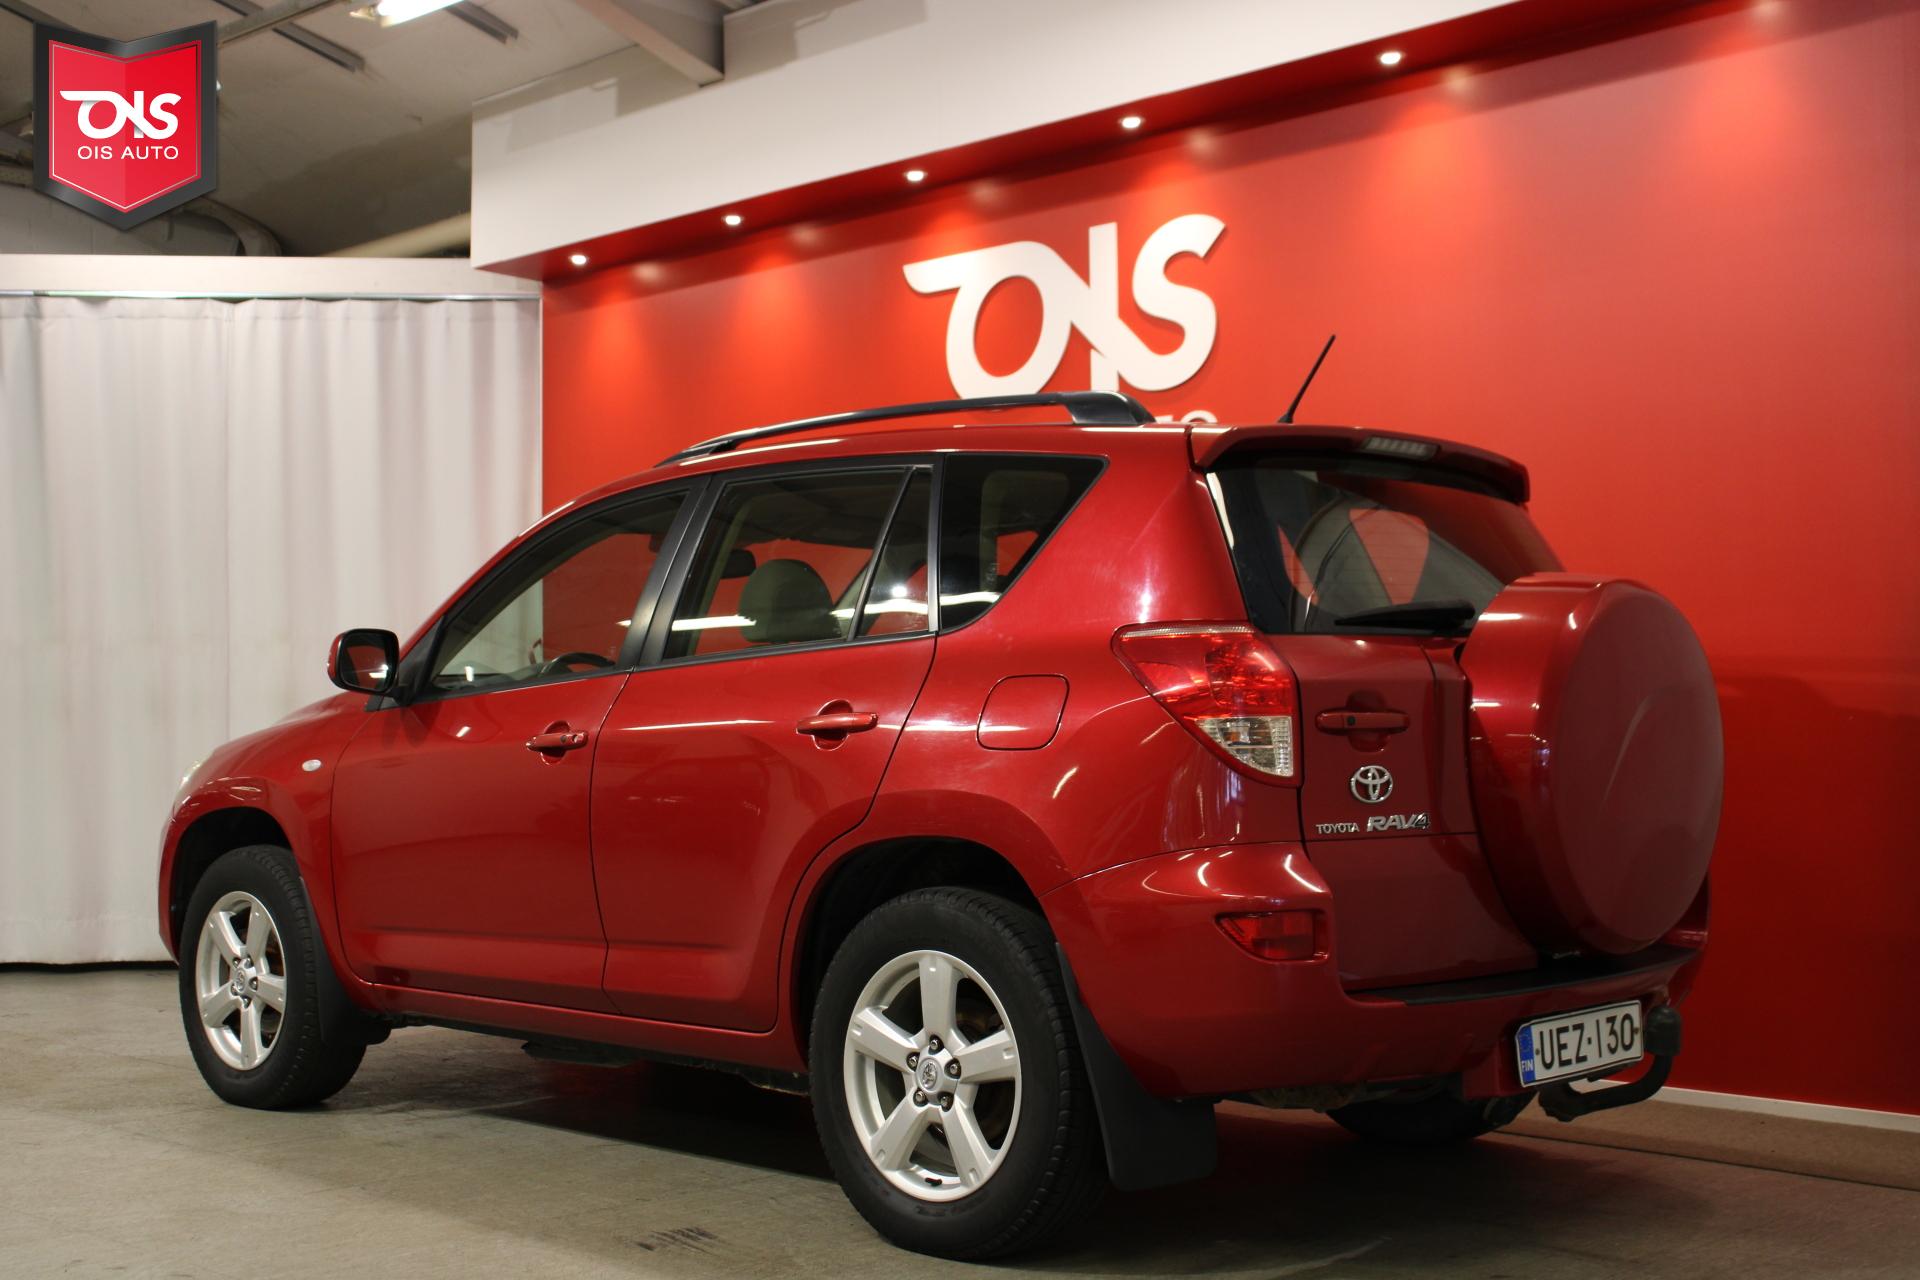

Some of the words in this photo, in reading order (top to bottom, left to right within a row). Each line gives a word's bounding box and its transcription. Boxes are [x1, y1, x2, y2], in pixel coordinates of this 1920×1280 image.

[903, 214, 1226, 399] OIS
[1316, 823, 1359, 834] TOYOTA
[1367, 813, 1429, 832] RAV4
[1521, 1059, 1534, 1072] FIN
